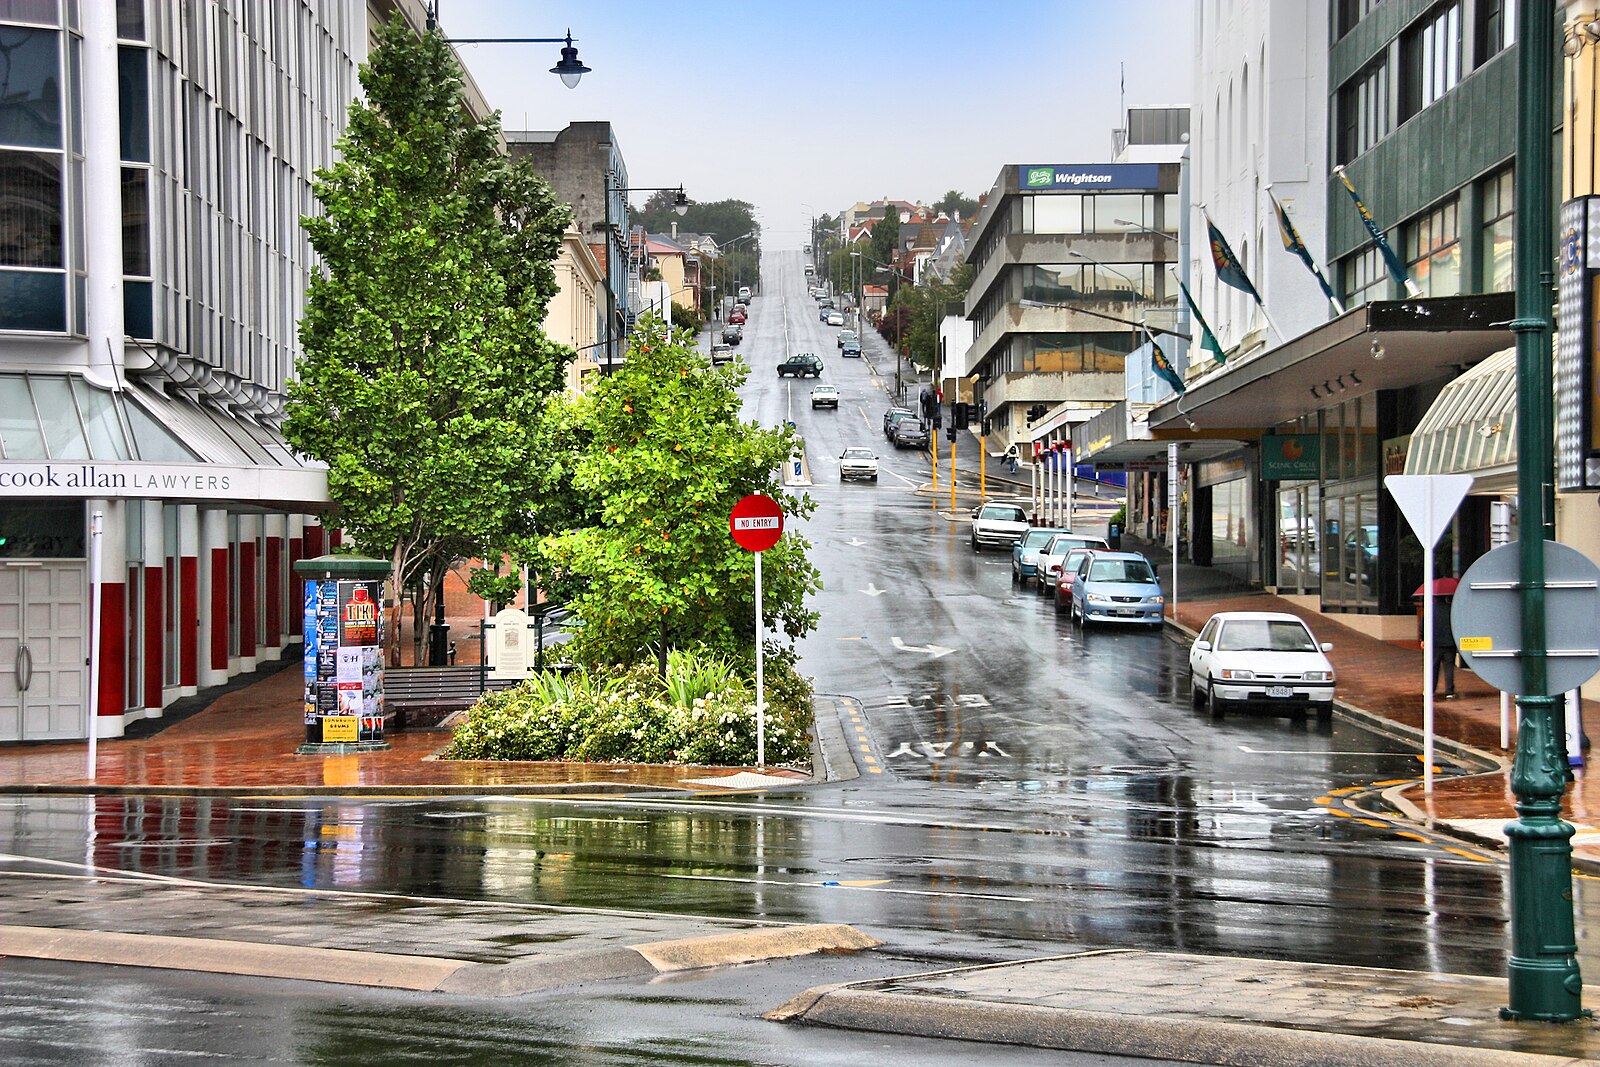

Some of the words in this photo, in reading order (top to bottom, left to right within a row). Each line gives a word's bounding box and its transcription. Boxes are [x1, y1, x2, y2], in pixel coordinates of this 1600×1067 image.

[1055, 173, 1112, 185] Wrightson
[0, 465, 61, 488] cook
[67, 466, 127, 488] allan
[133, 474, 231, 490] LAWYERS
[741, 519, 750, 527] NO
[753, 518, 772, 527] ENTRY
[346, 603, 375, 621] TIKI
